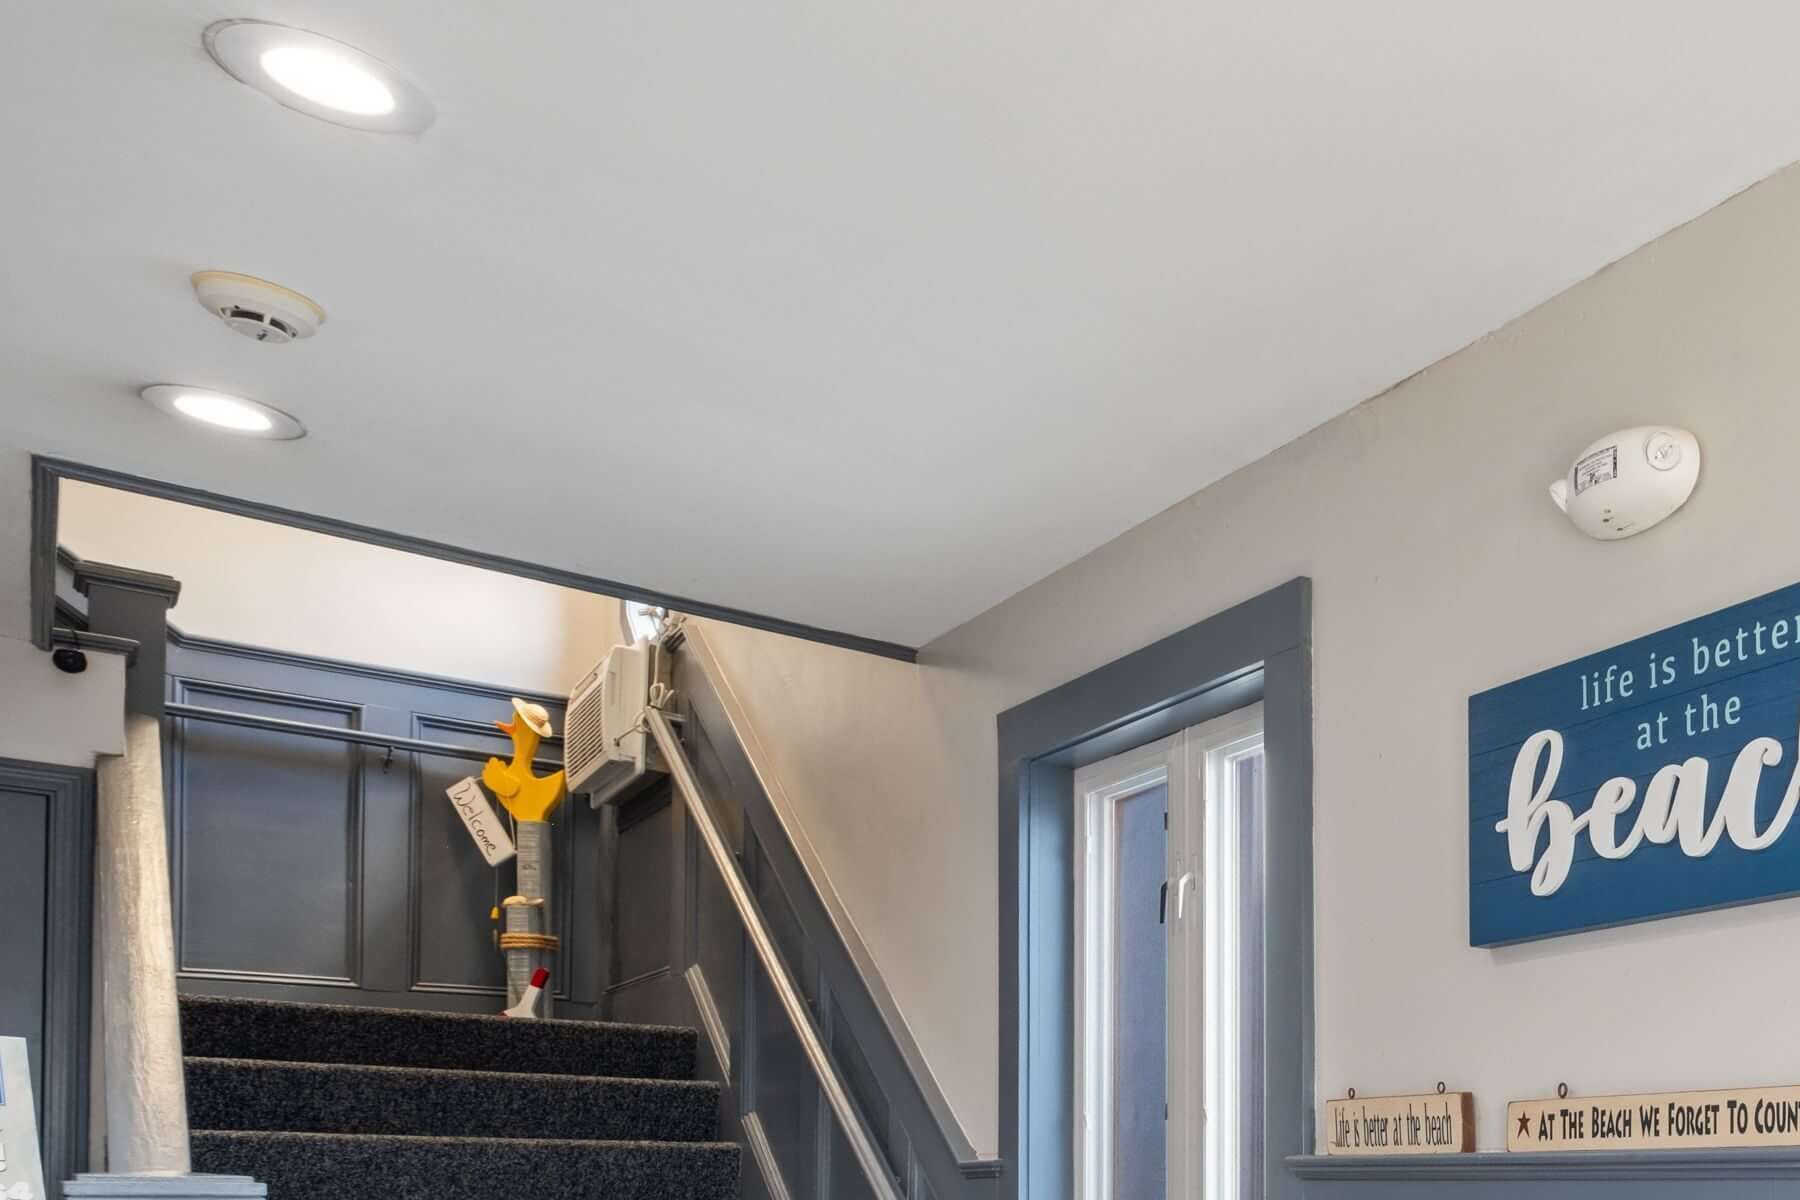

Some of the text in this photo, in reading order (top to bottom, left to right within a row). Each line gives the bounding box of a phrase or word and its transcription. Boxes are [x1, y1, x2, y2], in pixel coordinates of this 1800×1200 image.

[1580, 665, 1634, 711] life
[1649, 652, 1677, 689] is
[1636, 694, 1742, 751] at the
[451, 782, 496, 856] Welcome
[1353, 1111, 1360, 1147] is
[1362, 1104, 1389, 1148] better
[1393, 1114, 1402, 1146] at
[1406, 1103, 1421, 1146] the
[1424, 1102, 1453, 1145] beach
[1538, 1111, 1555, 1141] AT
[1560, 1108, 1584, 1139] THE
[1591, 1106, 1632, 1138] BEACH
[1639, 1104, 1660, 1136] WE
[1668, 1102, 1720, 1136] FORGET
[1727, 1100, 1748, 1134] TO
